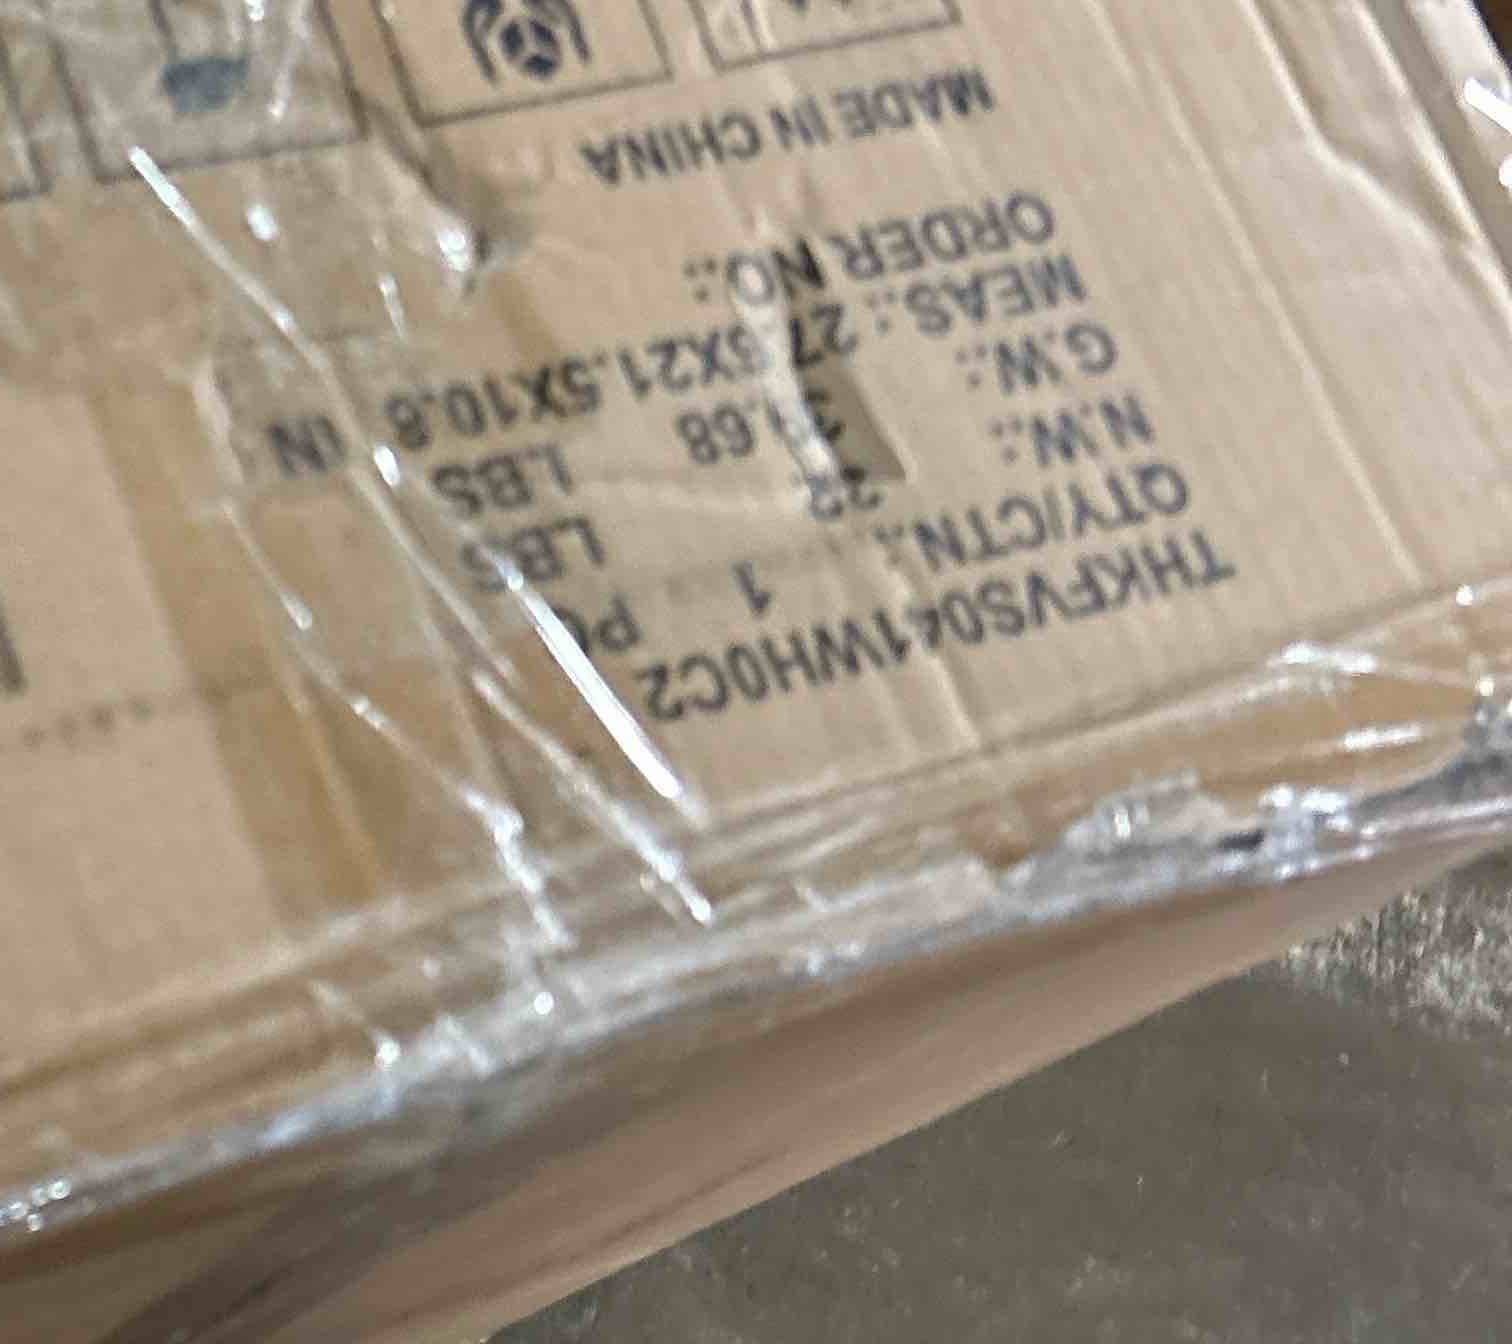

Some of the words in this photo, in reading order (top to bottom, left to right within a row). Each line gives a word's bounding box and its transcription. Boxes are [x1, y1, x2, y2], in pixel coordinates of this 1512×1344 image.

[770, 94, 830, 146] IN
[833, 66, 996, 138] MADE
[580, 108, 762, 187] CHINA
[829, 192, 1054, 279] ORDER
[432, 443, 573, 518] LBS
[733, 562, 773, 615] 1
